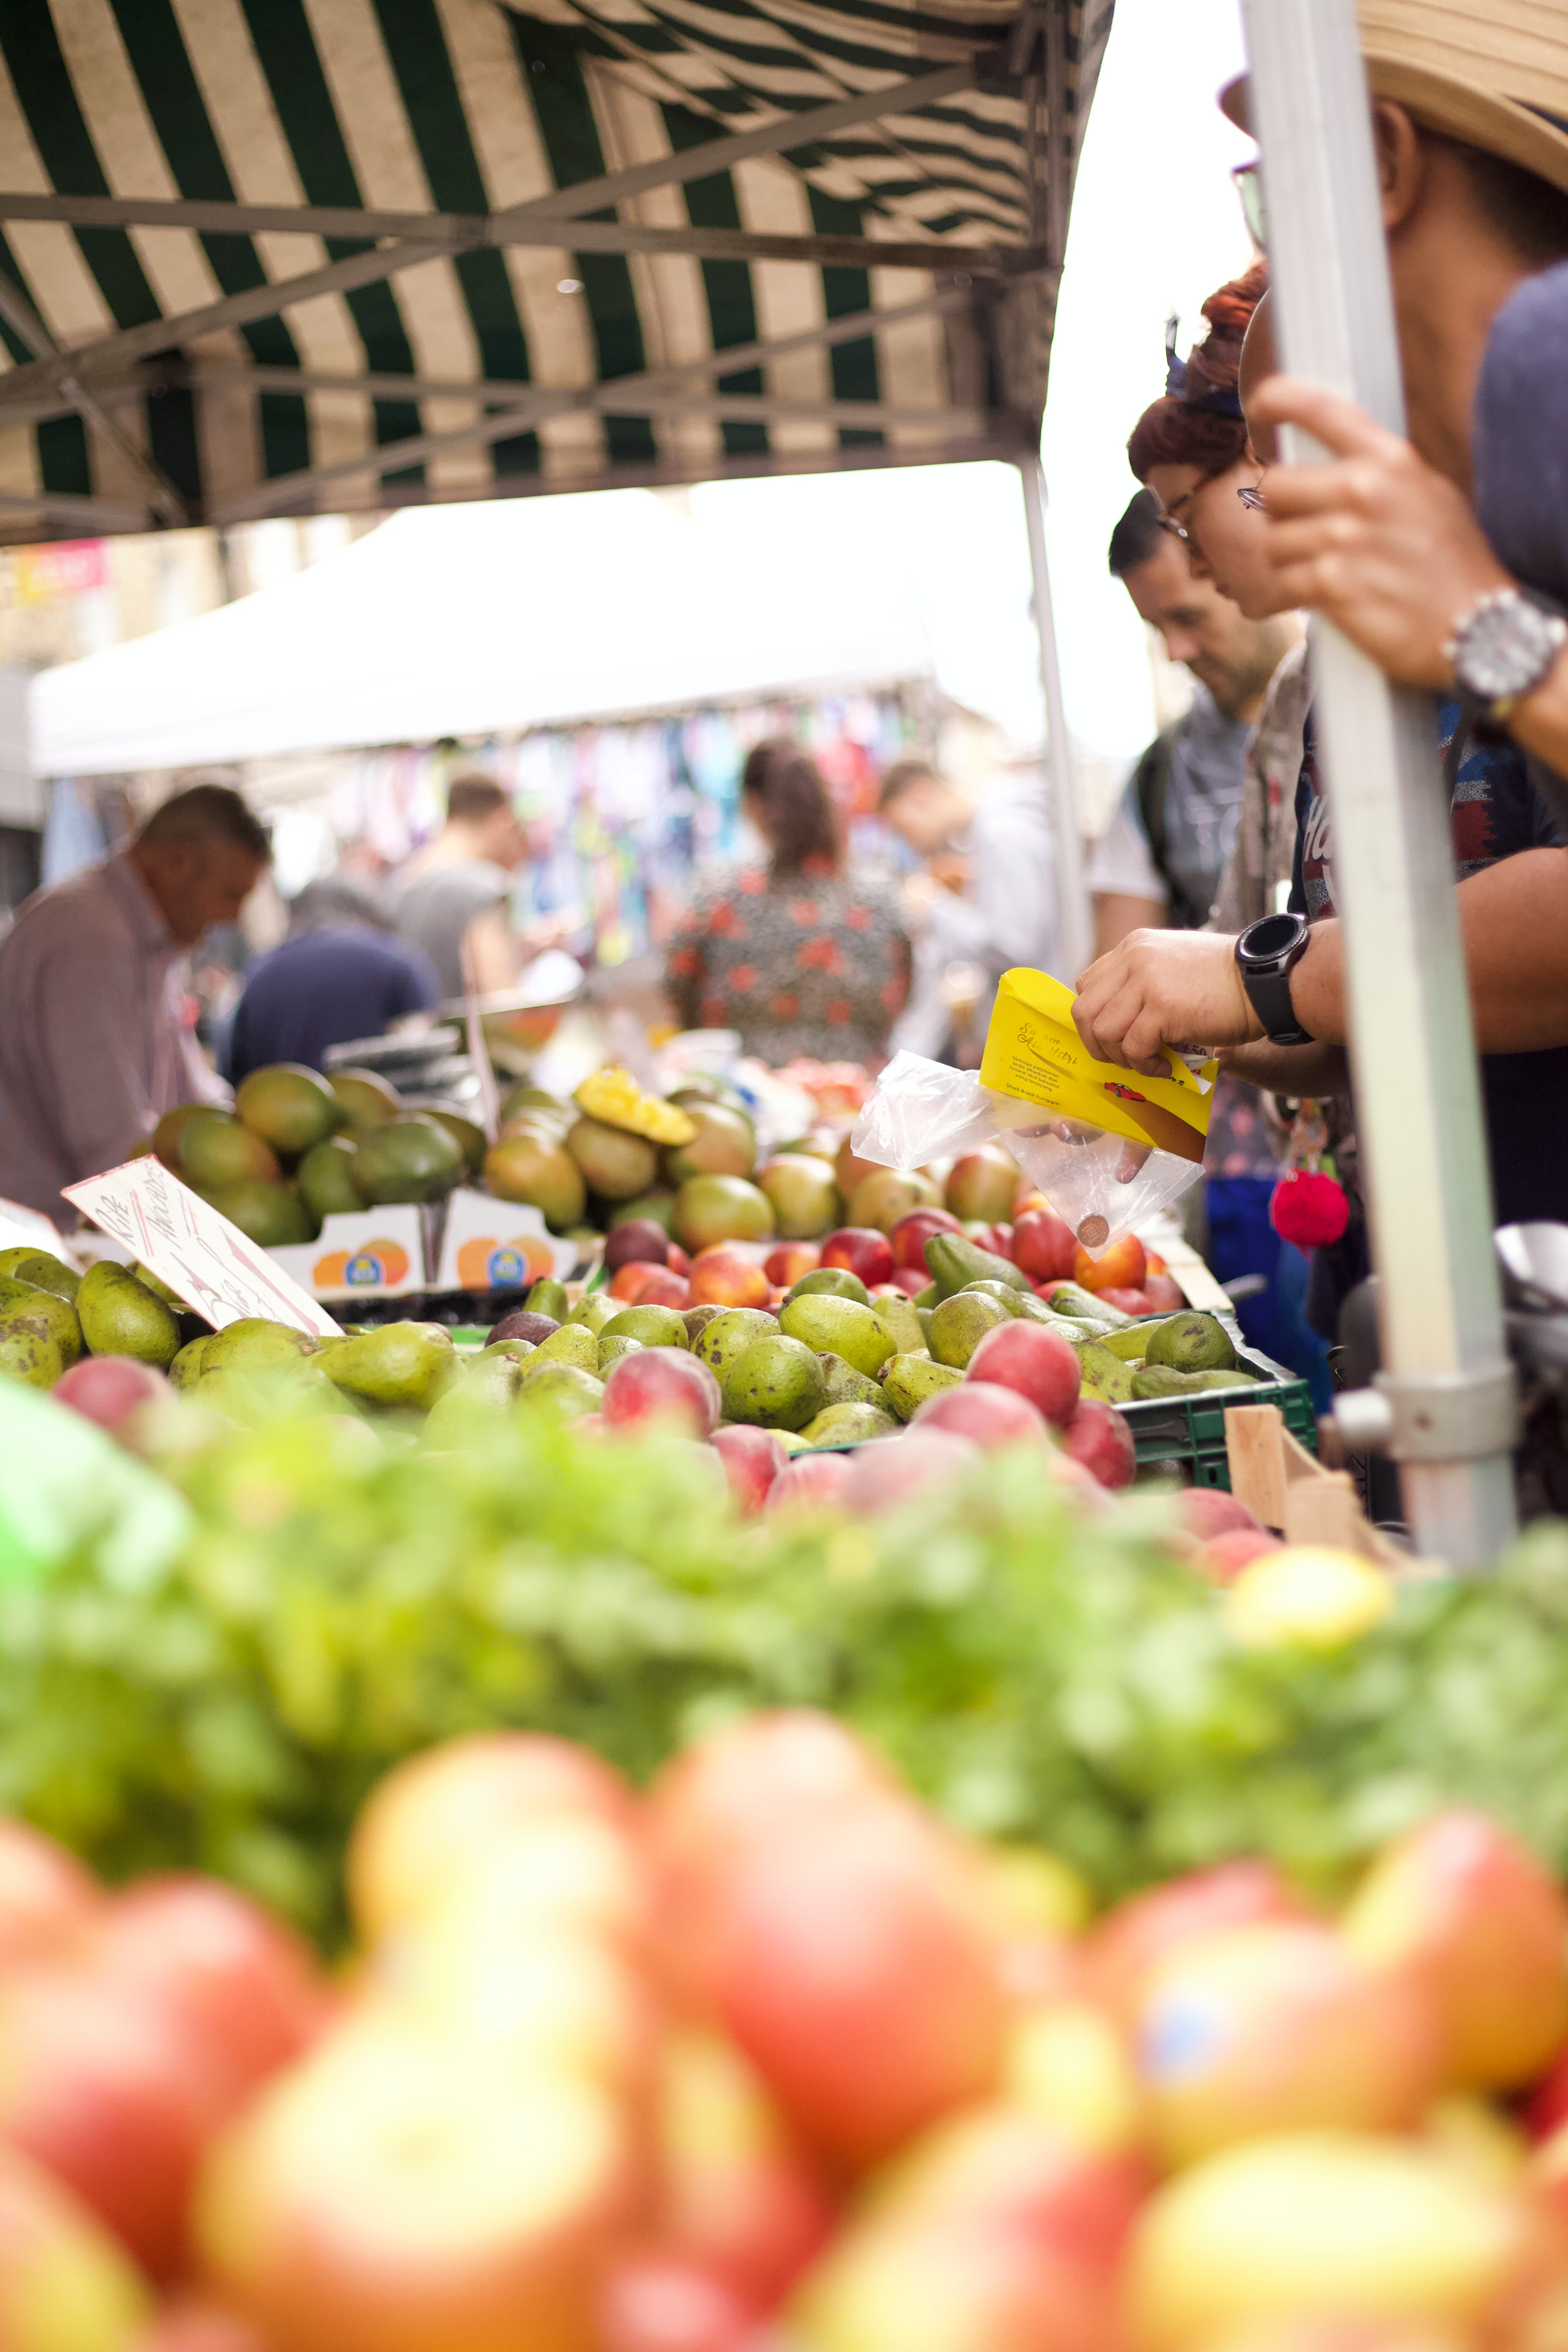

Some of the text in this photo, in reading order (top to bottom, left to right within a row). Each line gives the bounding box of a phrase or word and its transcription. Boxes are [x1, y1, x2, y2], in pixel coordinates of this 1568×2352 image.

[1019, 1022, 1061, 1045] Sam
[1009, 1065, 1026, 1075] Syawal
[1038, 1078, 1060, 1089] bersama
[1012, 1055, 1059, 1078] Semoga perjalanan
[1026, 1067, 1047, 1078] diberkati
[1006, 1083, 1059, 1106] Shell Bukit Tunggal
[1029, 1078, 1052, 1092] tersayang
